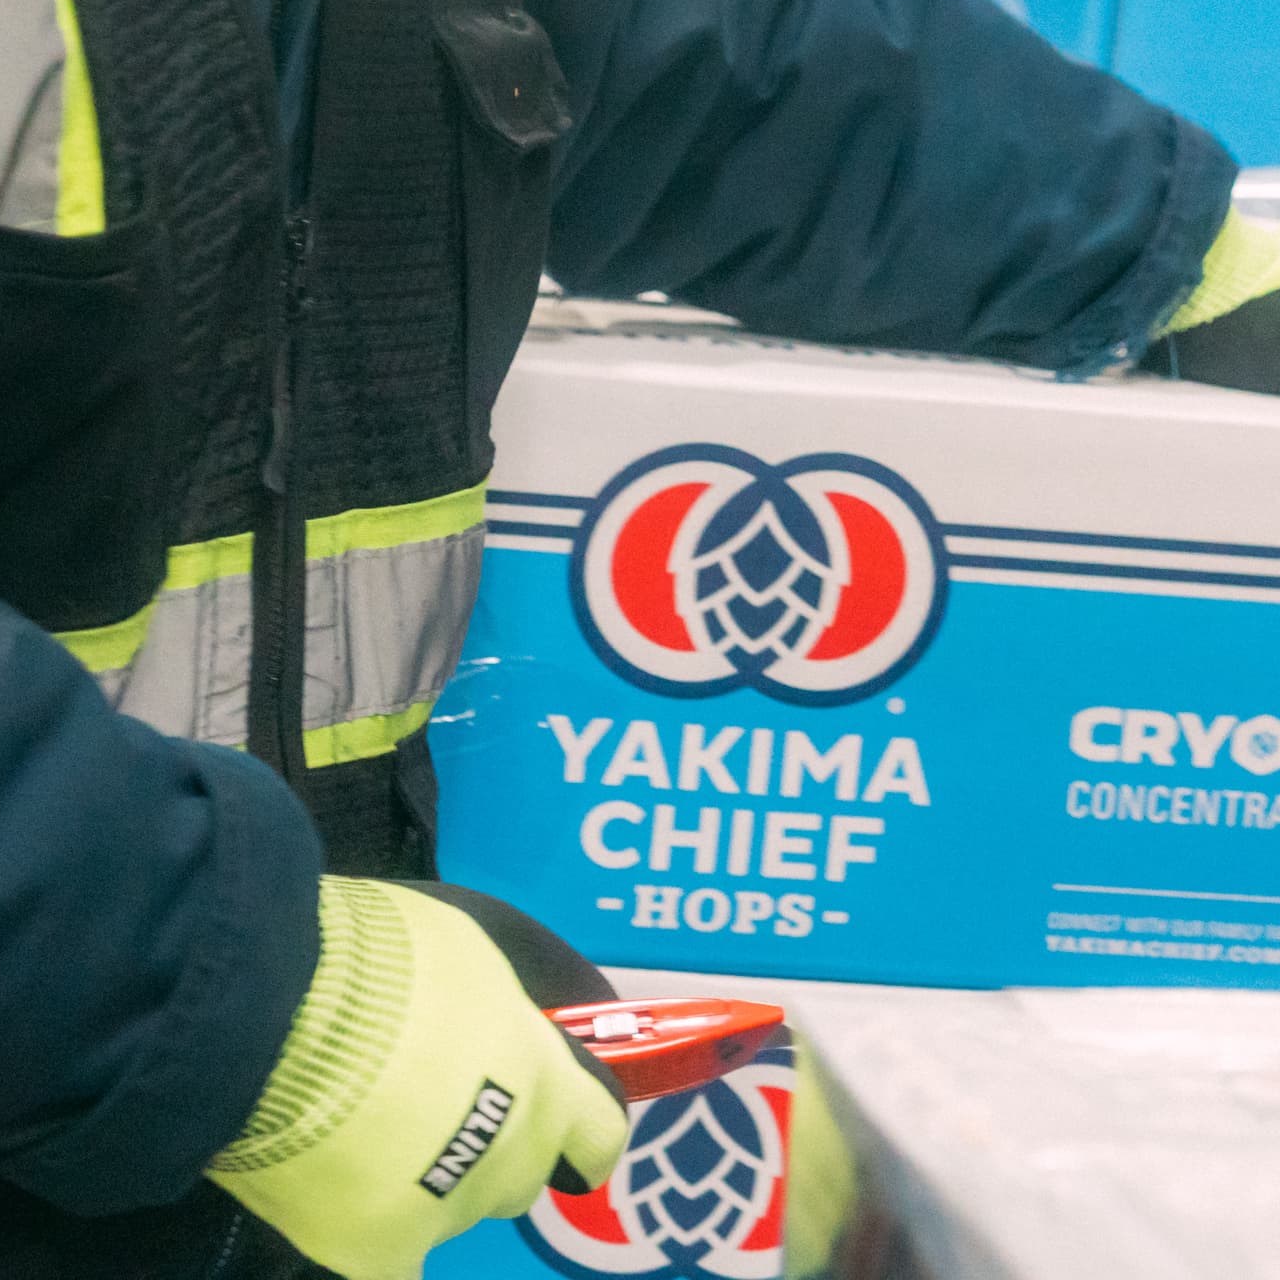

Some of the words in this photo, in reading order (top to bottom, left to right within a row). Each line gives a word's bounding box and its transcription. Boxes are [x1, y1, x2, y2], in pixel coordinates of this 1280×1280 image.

[539, 714, 931, 806] YAKIMA
[580, 800, 886, 882] CHIEF
[422, 1083, 512, 1196] ULINE
